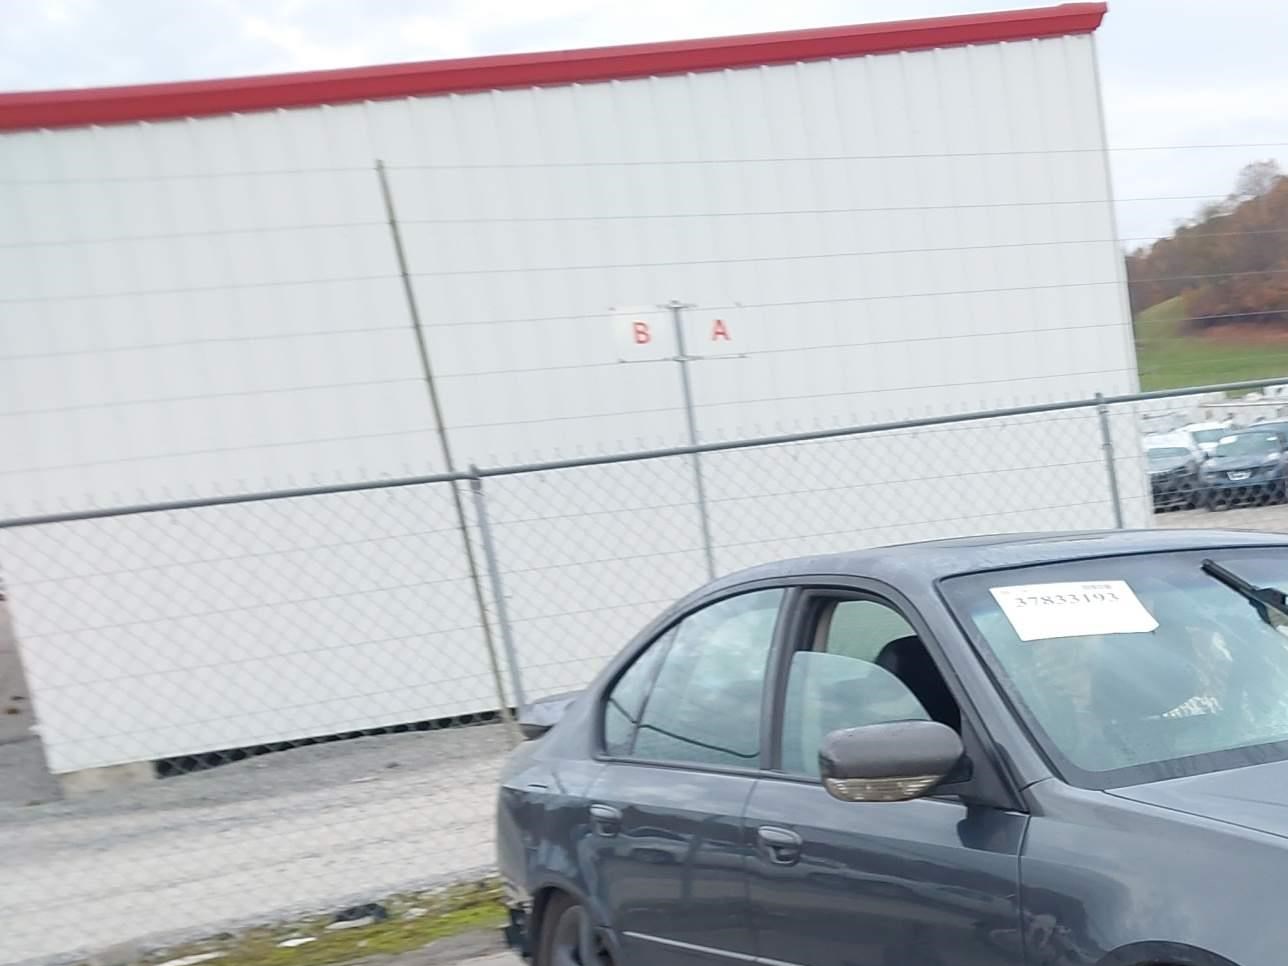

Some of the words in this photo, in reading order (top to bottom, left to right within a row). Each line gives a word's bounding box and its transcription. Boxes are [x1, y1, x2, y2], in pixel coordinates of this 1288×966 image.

[633, 321, 651, 344] B
[711, 319, 731, 341] A
[1014, 592, 1121, 608] 37833193
